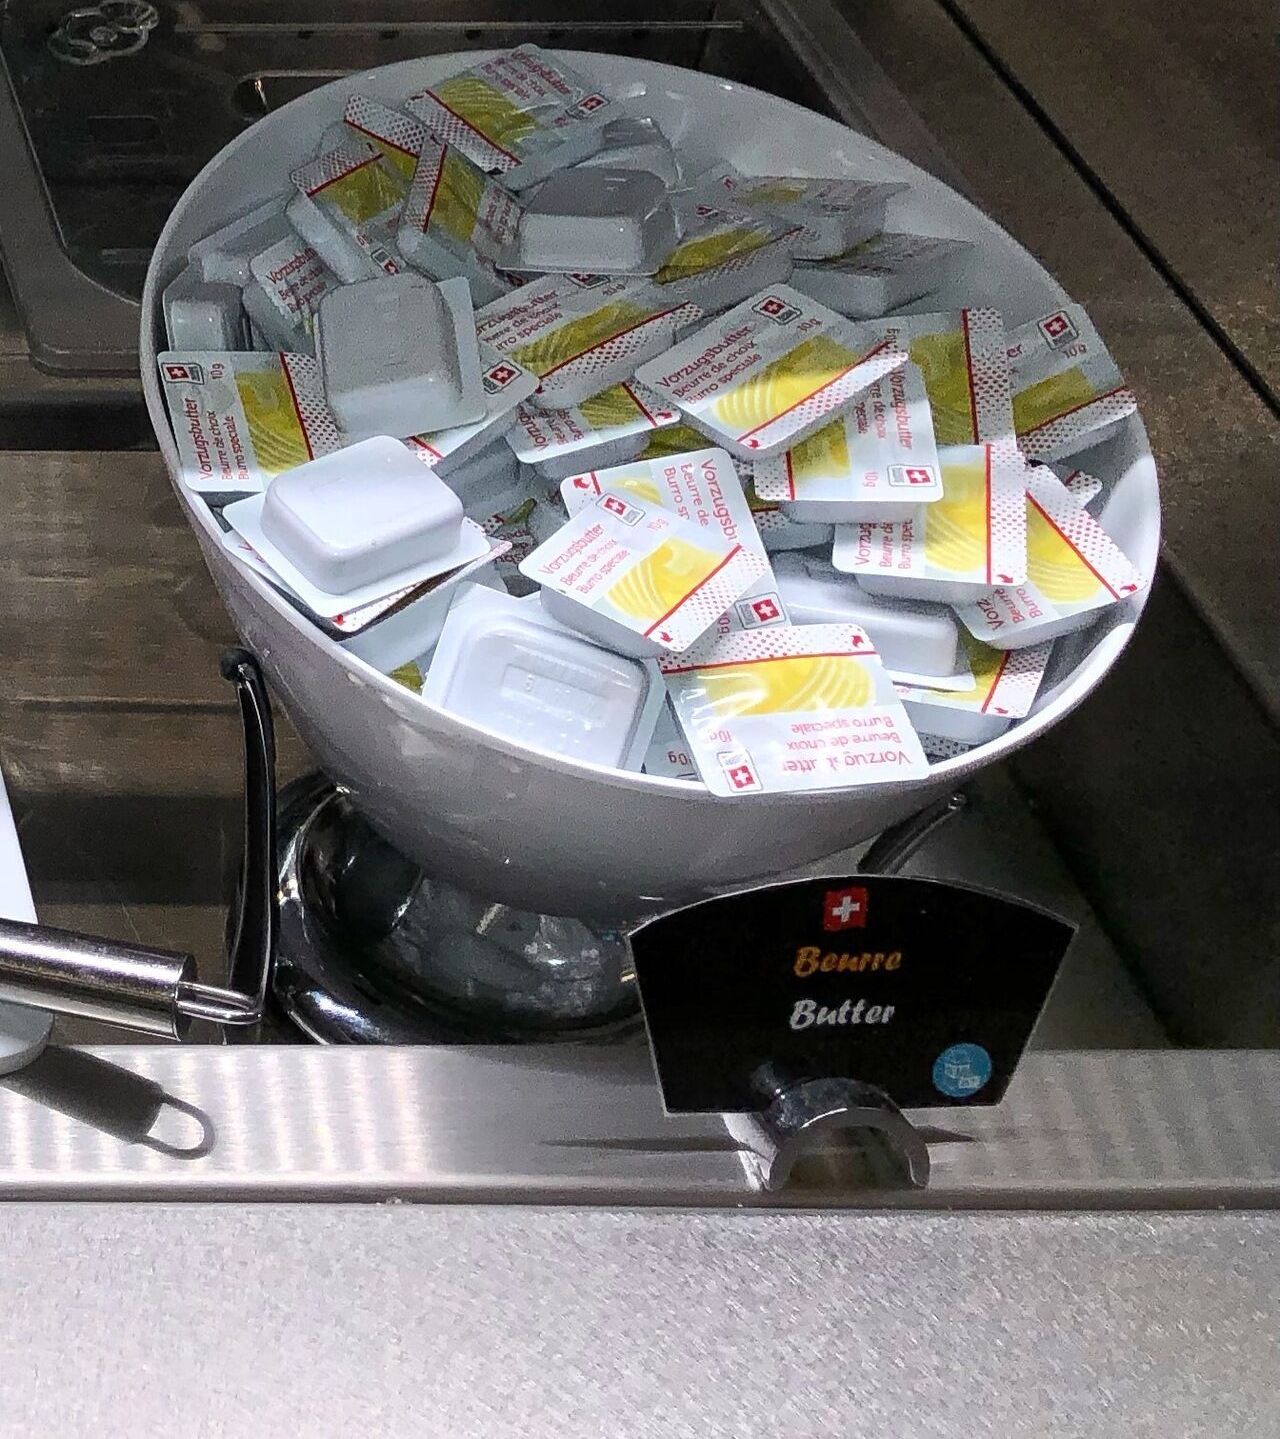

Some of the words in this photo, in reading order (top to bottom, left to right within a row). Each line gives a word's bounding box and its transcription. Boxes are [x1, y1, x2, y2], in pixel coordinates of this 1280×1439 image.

[210, 363, 225, 380] 10g
[656, 326, 752, 388] Vorzugsbutter
[185, 397, 213, 480] Vorzugsbutter
[664, 466, 683, 504] Burro
[700, 458, 737, 541] Vorzugsb
[697, 506, 709, 526] de
[1016, 588, 1043, 618] Burro
[668, 750, 688, 766] 0g
[793, 945, 902, 978] Beurre
[790, 998, 896, 1031] Butter
